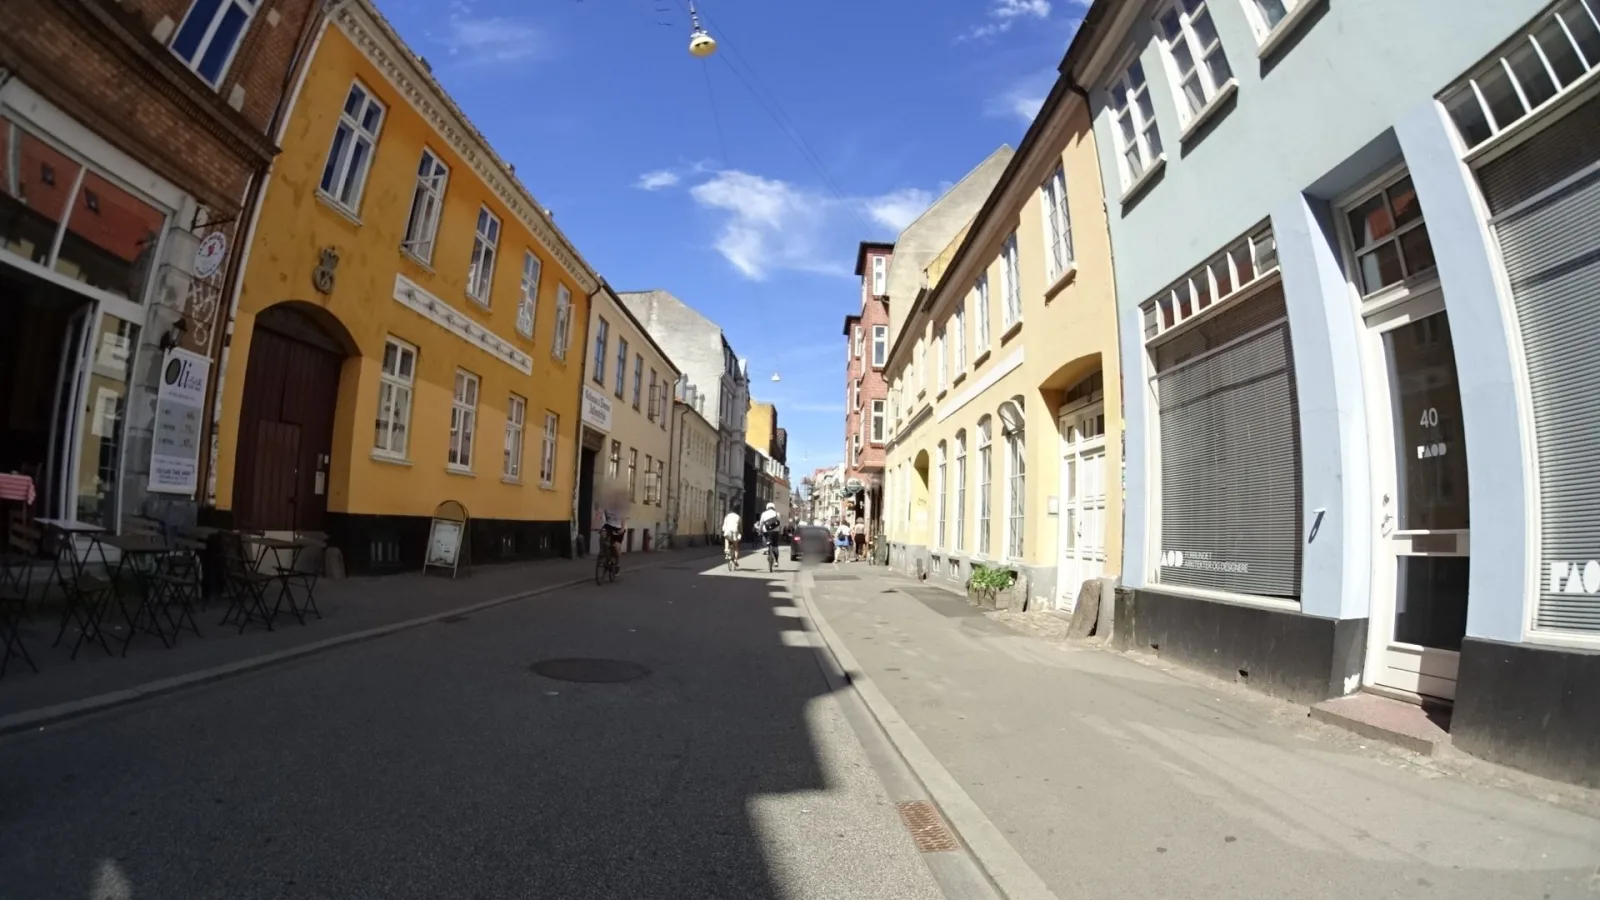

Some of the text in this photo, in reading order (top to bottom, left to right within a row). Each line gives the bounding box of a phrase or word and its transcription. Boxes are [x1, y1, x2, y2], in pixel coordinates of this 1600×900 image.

[1420, 407, 1438, 428] 40
[1417, 442, 1447, 459] FAOD
[1160, 551, 1183, 567] AOD
